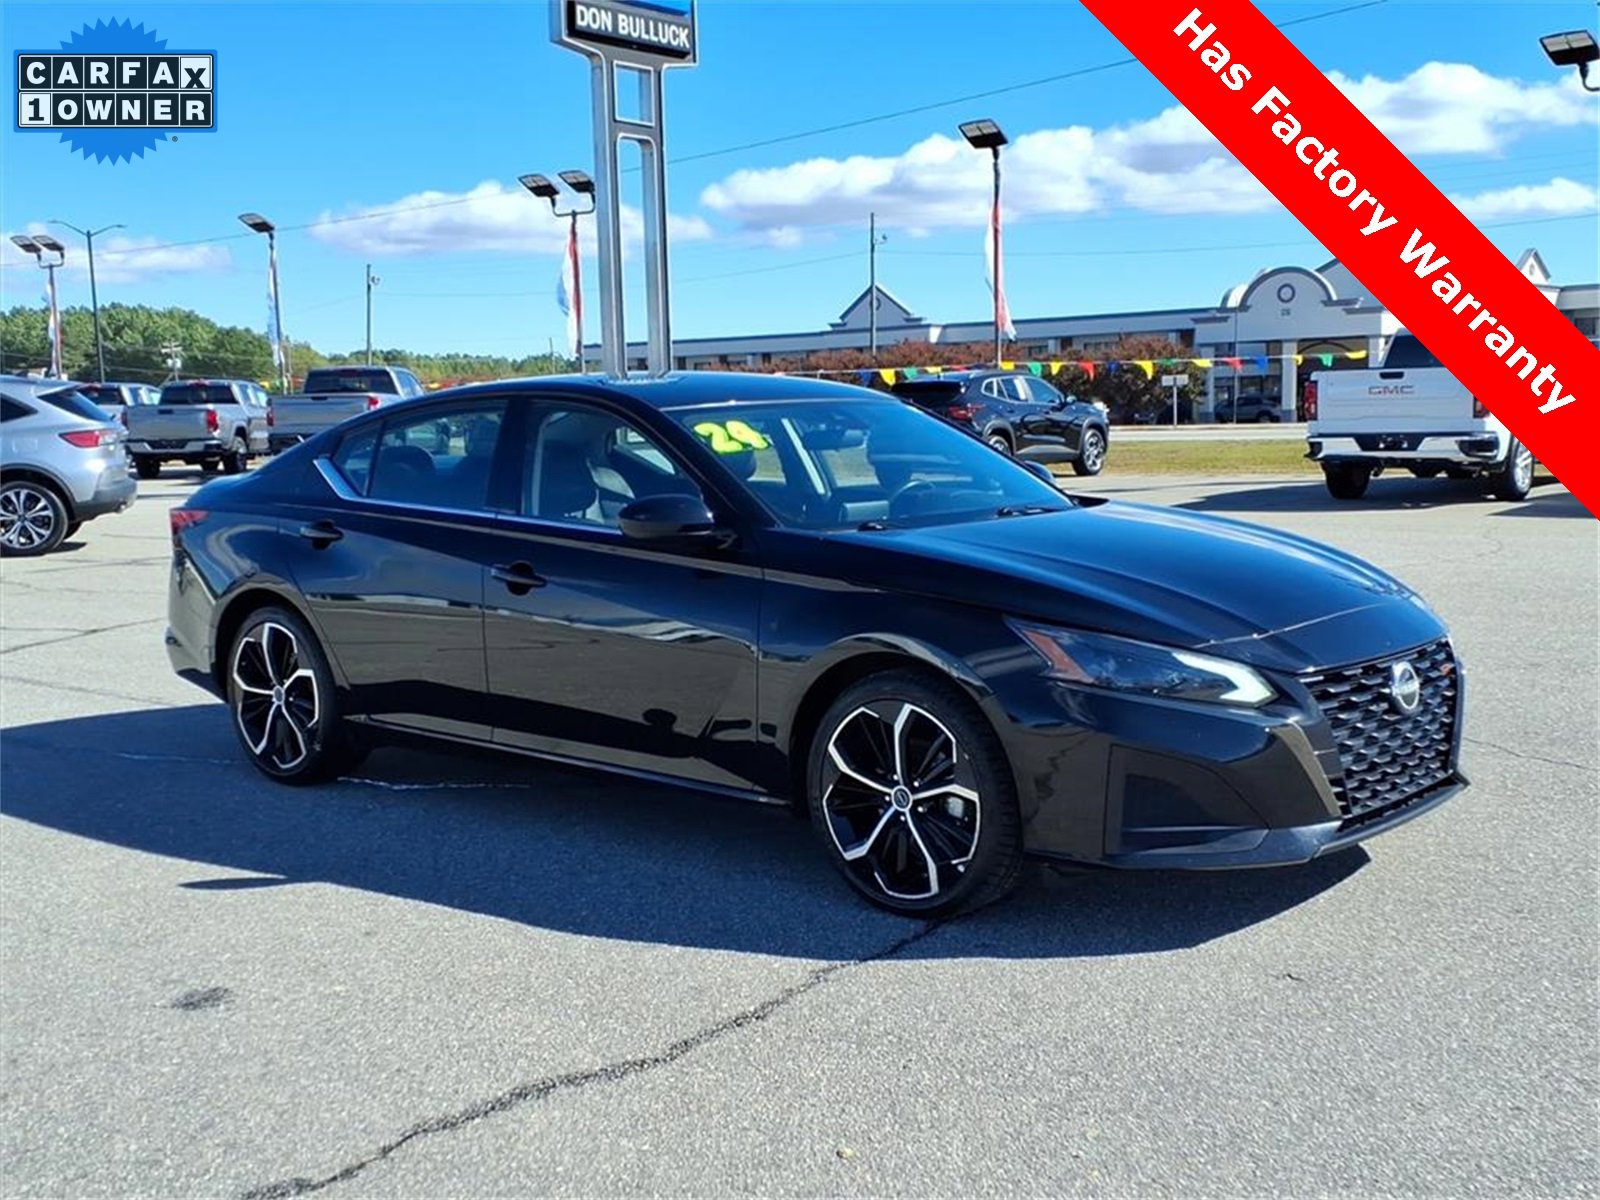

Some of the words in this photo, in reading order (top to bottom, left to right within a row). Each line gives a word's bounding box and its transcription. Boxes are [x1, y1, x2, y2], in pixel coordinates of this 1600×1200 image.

[576, 4, 613, 32] DON
[617, 13, 690, 48] BULLUCK
[1368, 385, 1414, 395] GMC
[693, 420, 769, 454] 24
